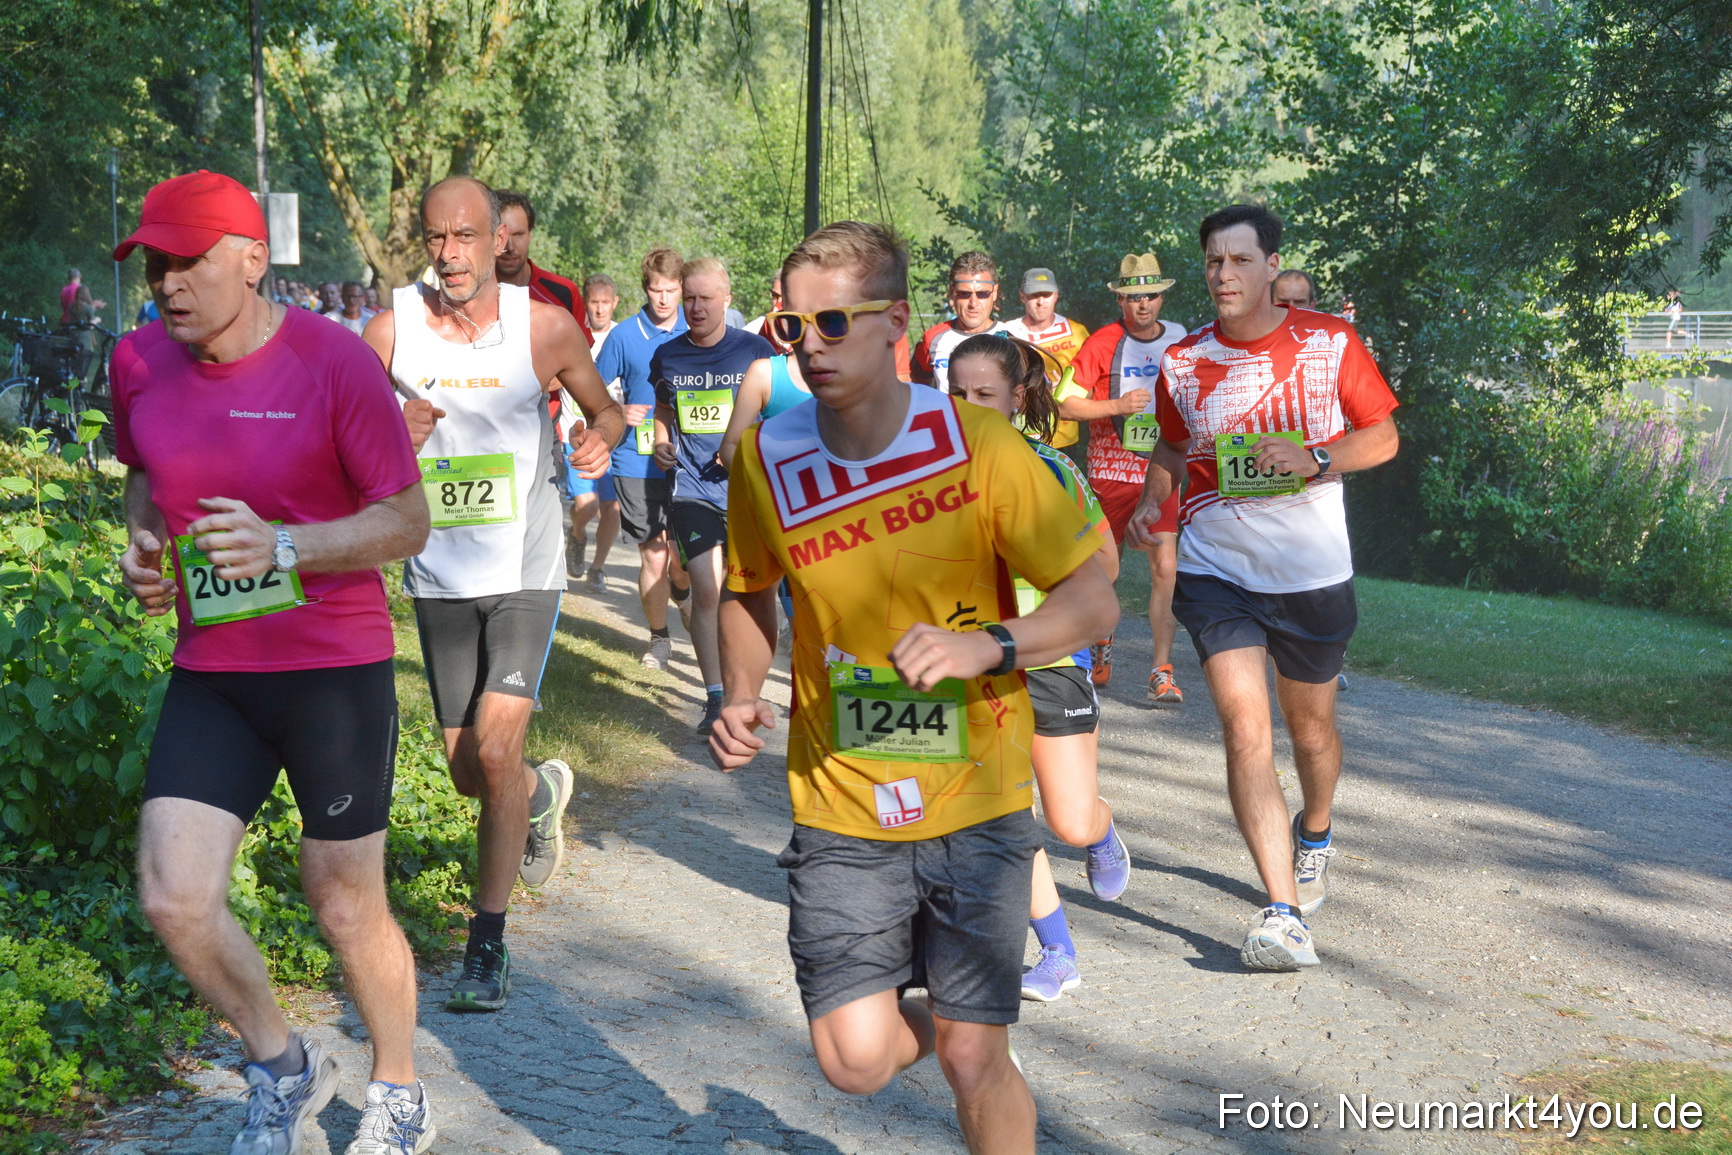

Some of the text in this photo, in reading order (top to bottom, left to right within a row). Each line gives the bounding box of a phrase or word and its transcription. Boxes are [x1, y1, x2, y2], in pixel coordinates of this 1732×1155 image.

[440, 377, 506, 389] KLEBL
[673, 375, 704, 386] EURO
[229, 409, 297, 420] Dietmar Richter
[690, 405, 720, 421] 492
[1110, 460, 1142, 472] AVIA
[1227, 456, 1293, 479] 18
[1097, 470, 1128, 482] AVIA
[1227, 479, 1267, 487] Moosburger
[440, 480, 495, 507] 872
[787, 479, 980, 570] MAX BÖGL
[727, 564, 757, 580] l.de
[847, 697, 949, 737] 1244
[1065, 706, 1093, 718] hummel
[865, 734, 931, 746] Müller Julian
[883, 745, 922, 754] Bauservice
[923, 746, 946, 754] GmbH
